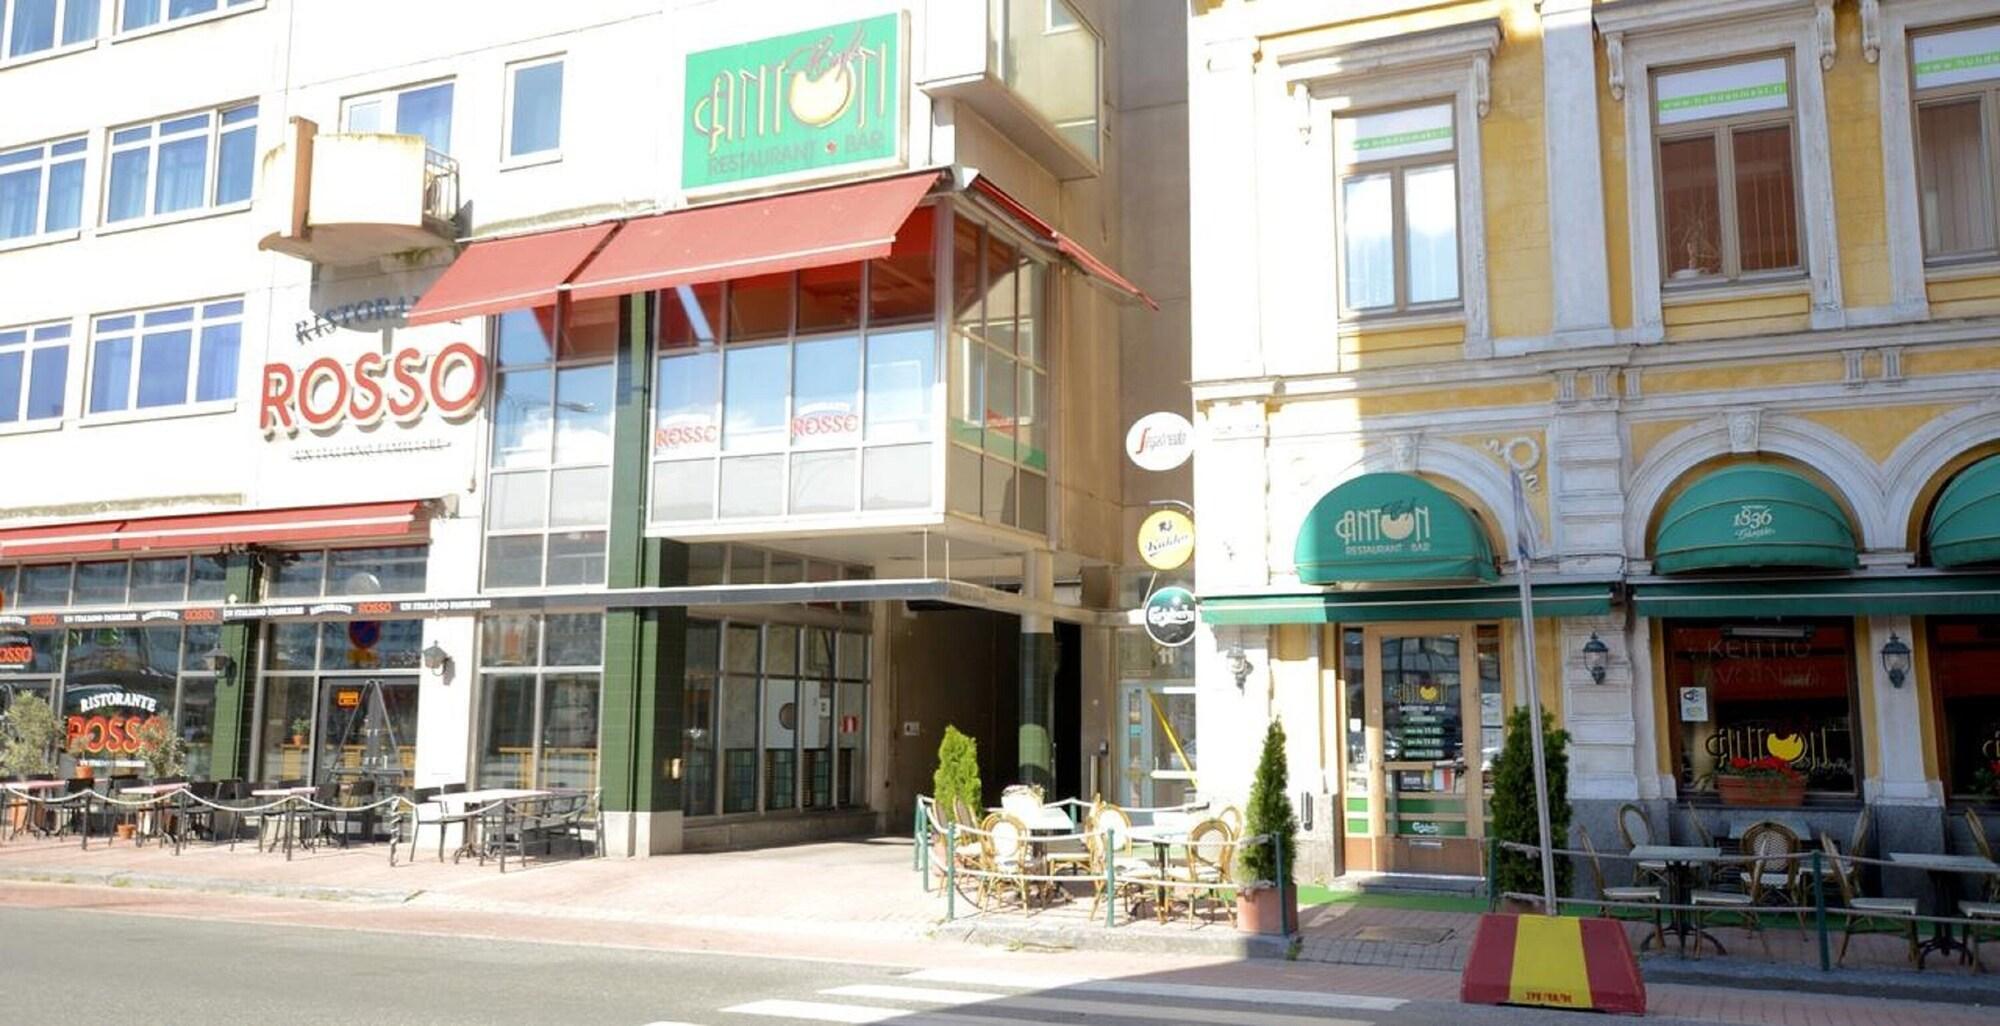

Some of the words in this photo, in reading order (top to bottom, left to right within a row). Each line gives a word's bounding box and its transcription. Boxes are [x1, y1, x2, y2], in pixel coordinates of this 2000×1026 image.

[694, 42, 887, 155] ANTON
[708, 140, 817, 177] RESTAURANT
[845, 131, 885, 153] BAR
[260, 342, 486, 436] ROSSO
[1336, 505, 1431, 545] ANTON
[1734, 508, 1773, 529] 1836
[80, 692, 157, 712] RISTORANTE
